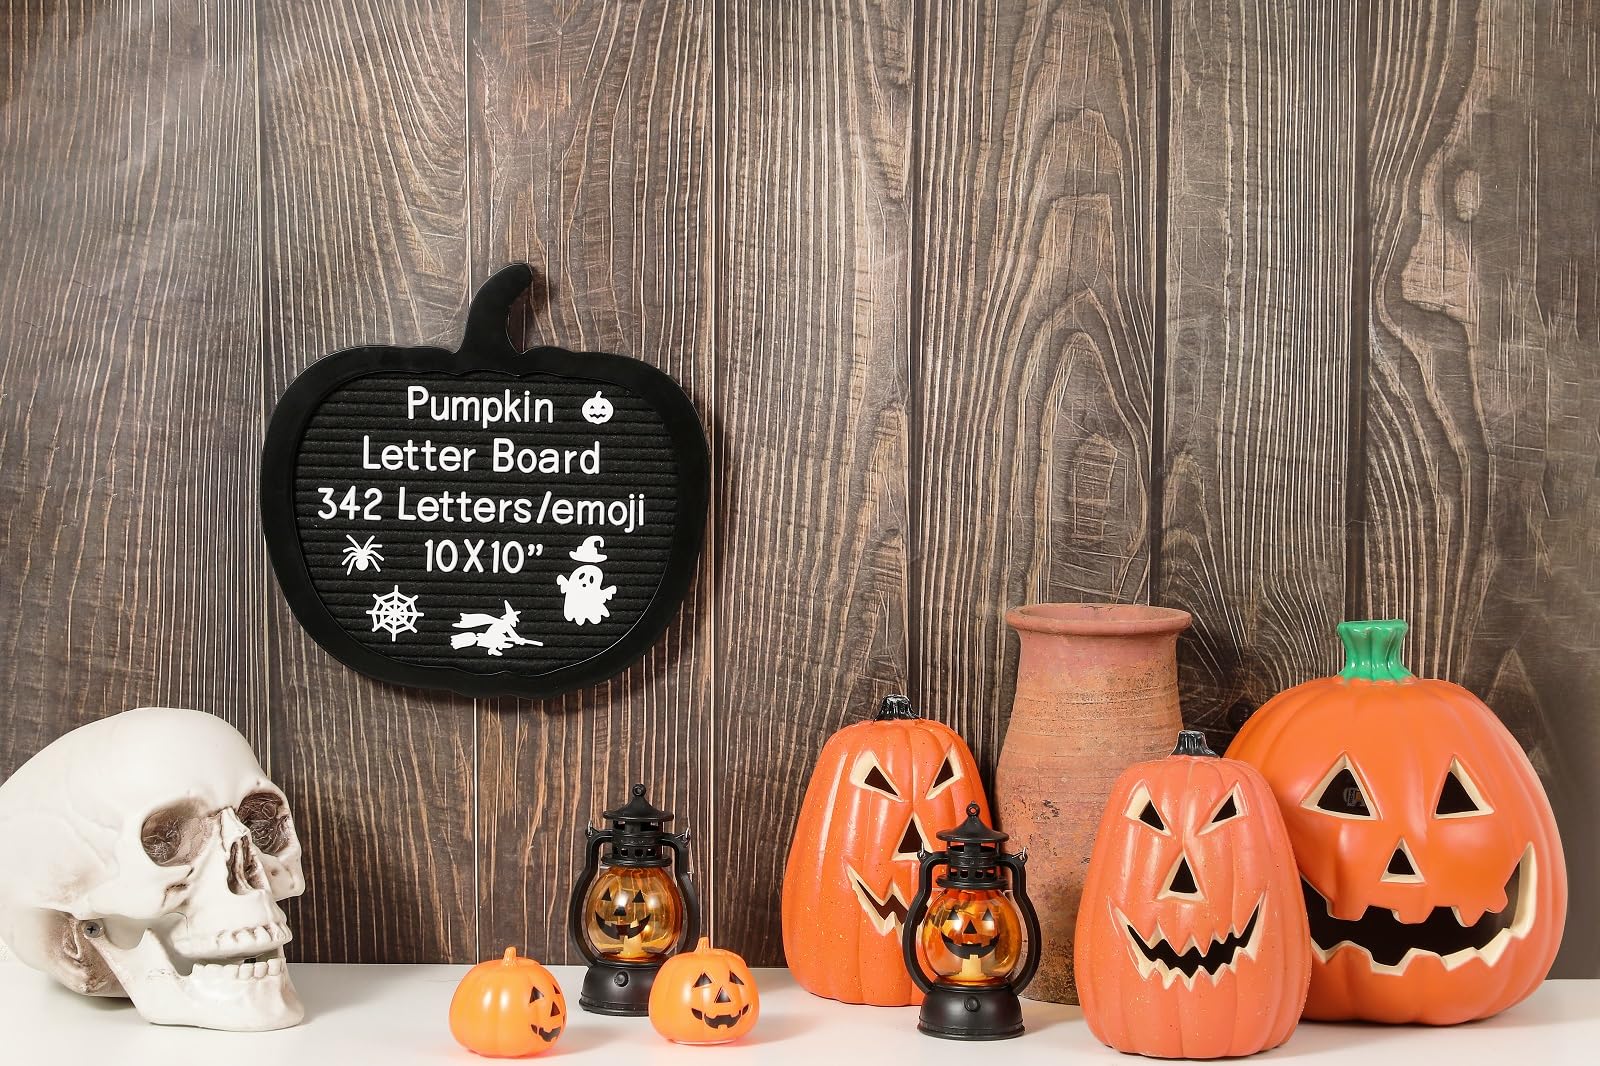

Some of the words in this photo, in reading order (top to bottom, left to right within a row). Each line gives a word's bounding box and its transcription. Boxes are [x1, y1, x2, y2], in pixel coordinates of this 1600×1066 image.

[407, 385, 554, 429] Pumpkin
[362, 434, 477, 473] Letter
[492, 437, 600, 475] Board
[317, 485, 383, 521] 342
[398, 486, 645, 534] Letters/emoji
